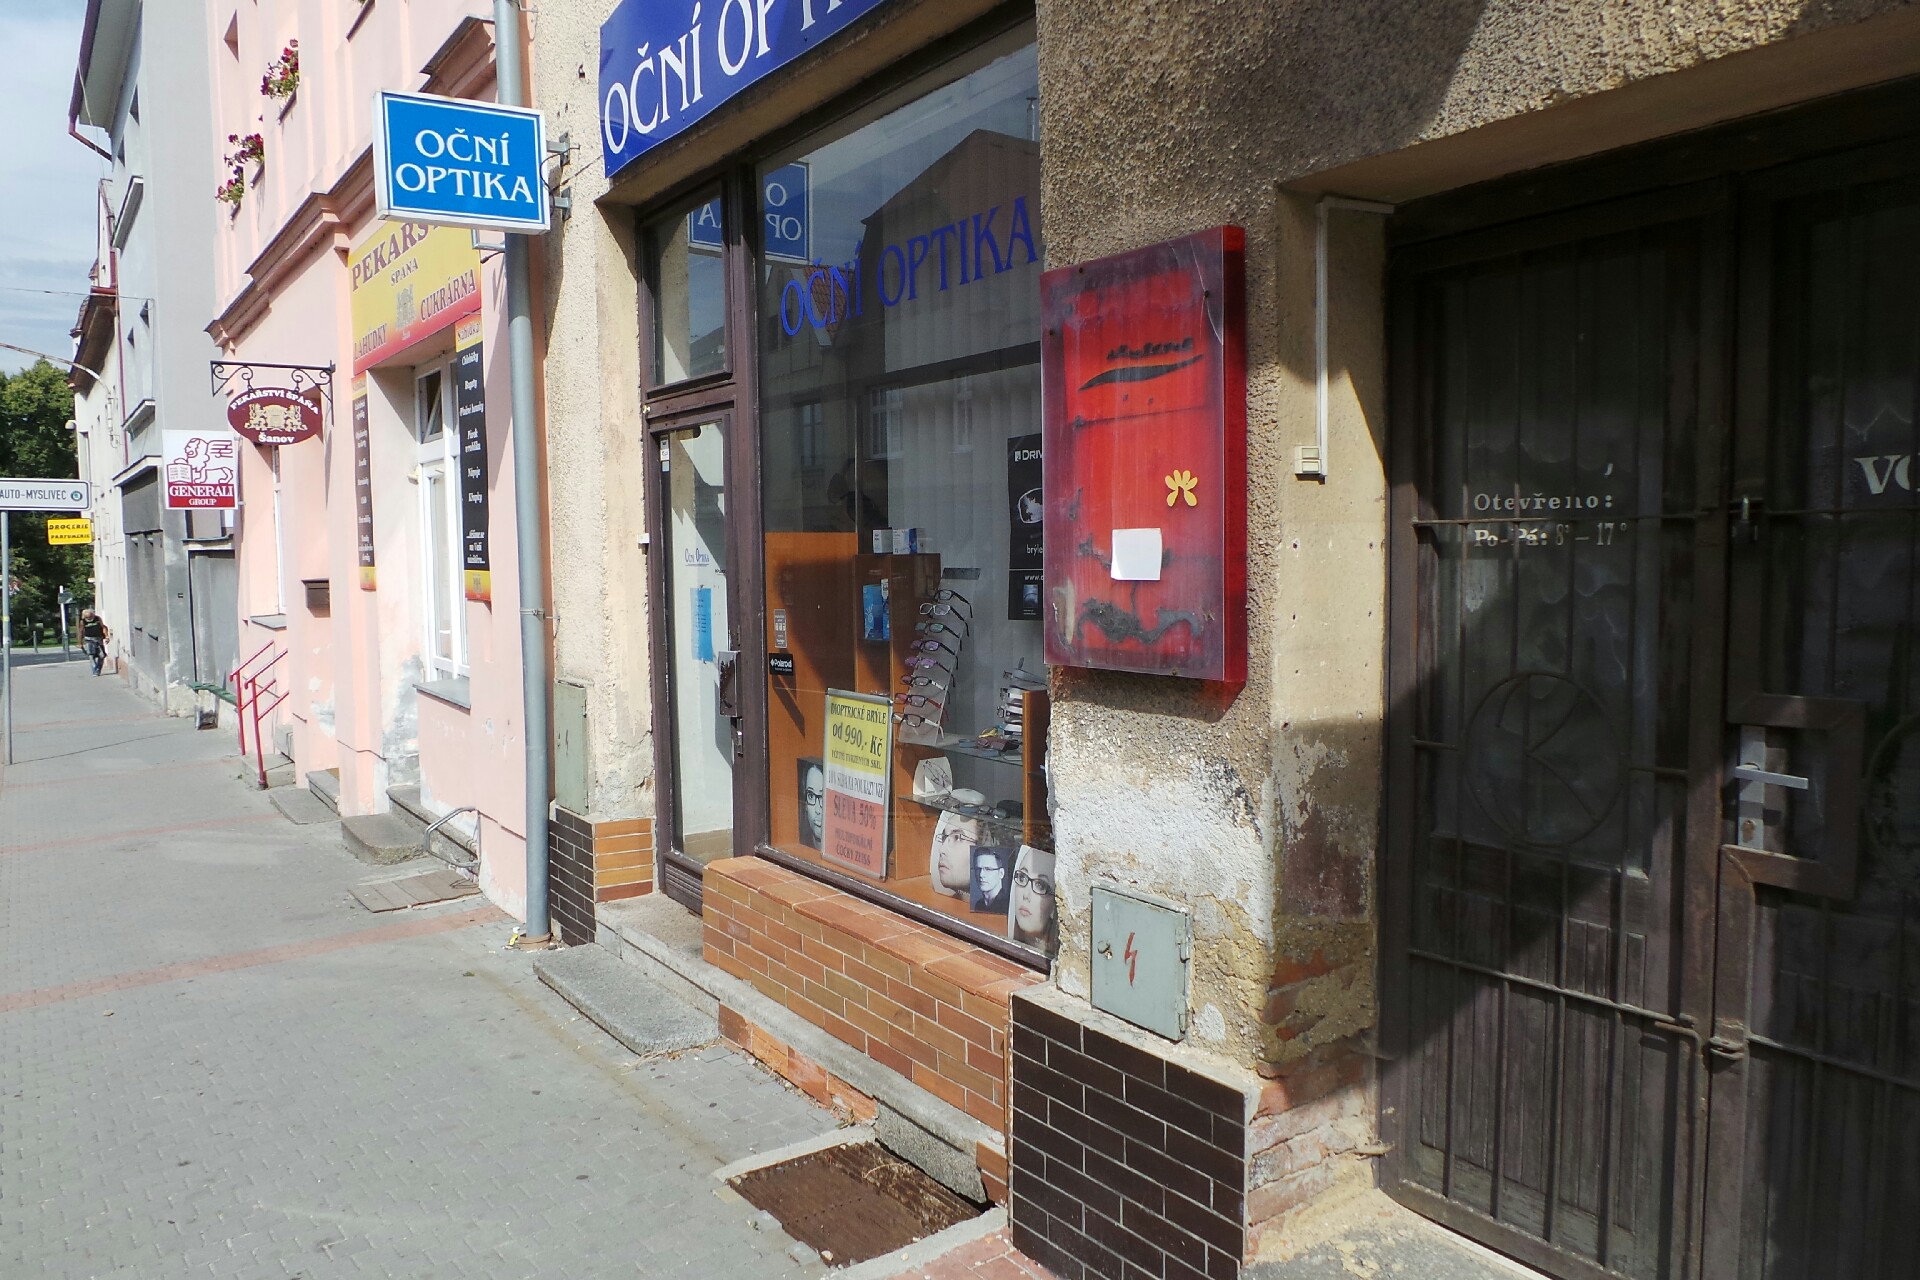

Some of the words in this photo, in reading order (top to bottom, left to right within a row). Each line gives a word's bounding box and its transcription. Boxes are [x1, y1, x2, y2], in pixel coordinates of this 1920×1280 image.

[605, 2, 703, 154] OČNÍ
[415, 128, 510, 166] OČNÍ
[396, 163, 535, 204] OPTIKA
[780, 240, 864, 337] OČNÍ
[876, 195, 1039, 308] OPTIKA
[420, 269, 476, 321] CUKRÁRNA
[258, 431, 295, 443] Šanov
[0, 489, 67, 500] AUTO-MYSLIVEC
[169, 485, 234, 497] GENERALI
[188, 498, 217, 506] GROUP
[1474, 493, 1614, 511] Otevřeno:
[831, 702, 865, 722] DIOPTRICKÉ
[866, 706, 886, 725] BRÝLE
[832, 722, 843, 740] od
[870, 735, 883, 757] Kč
